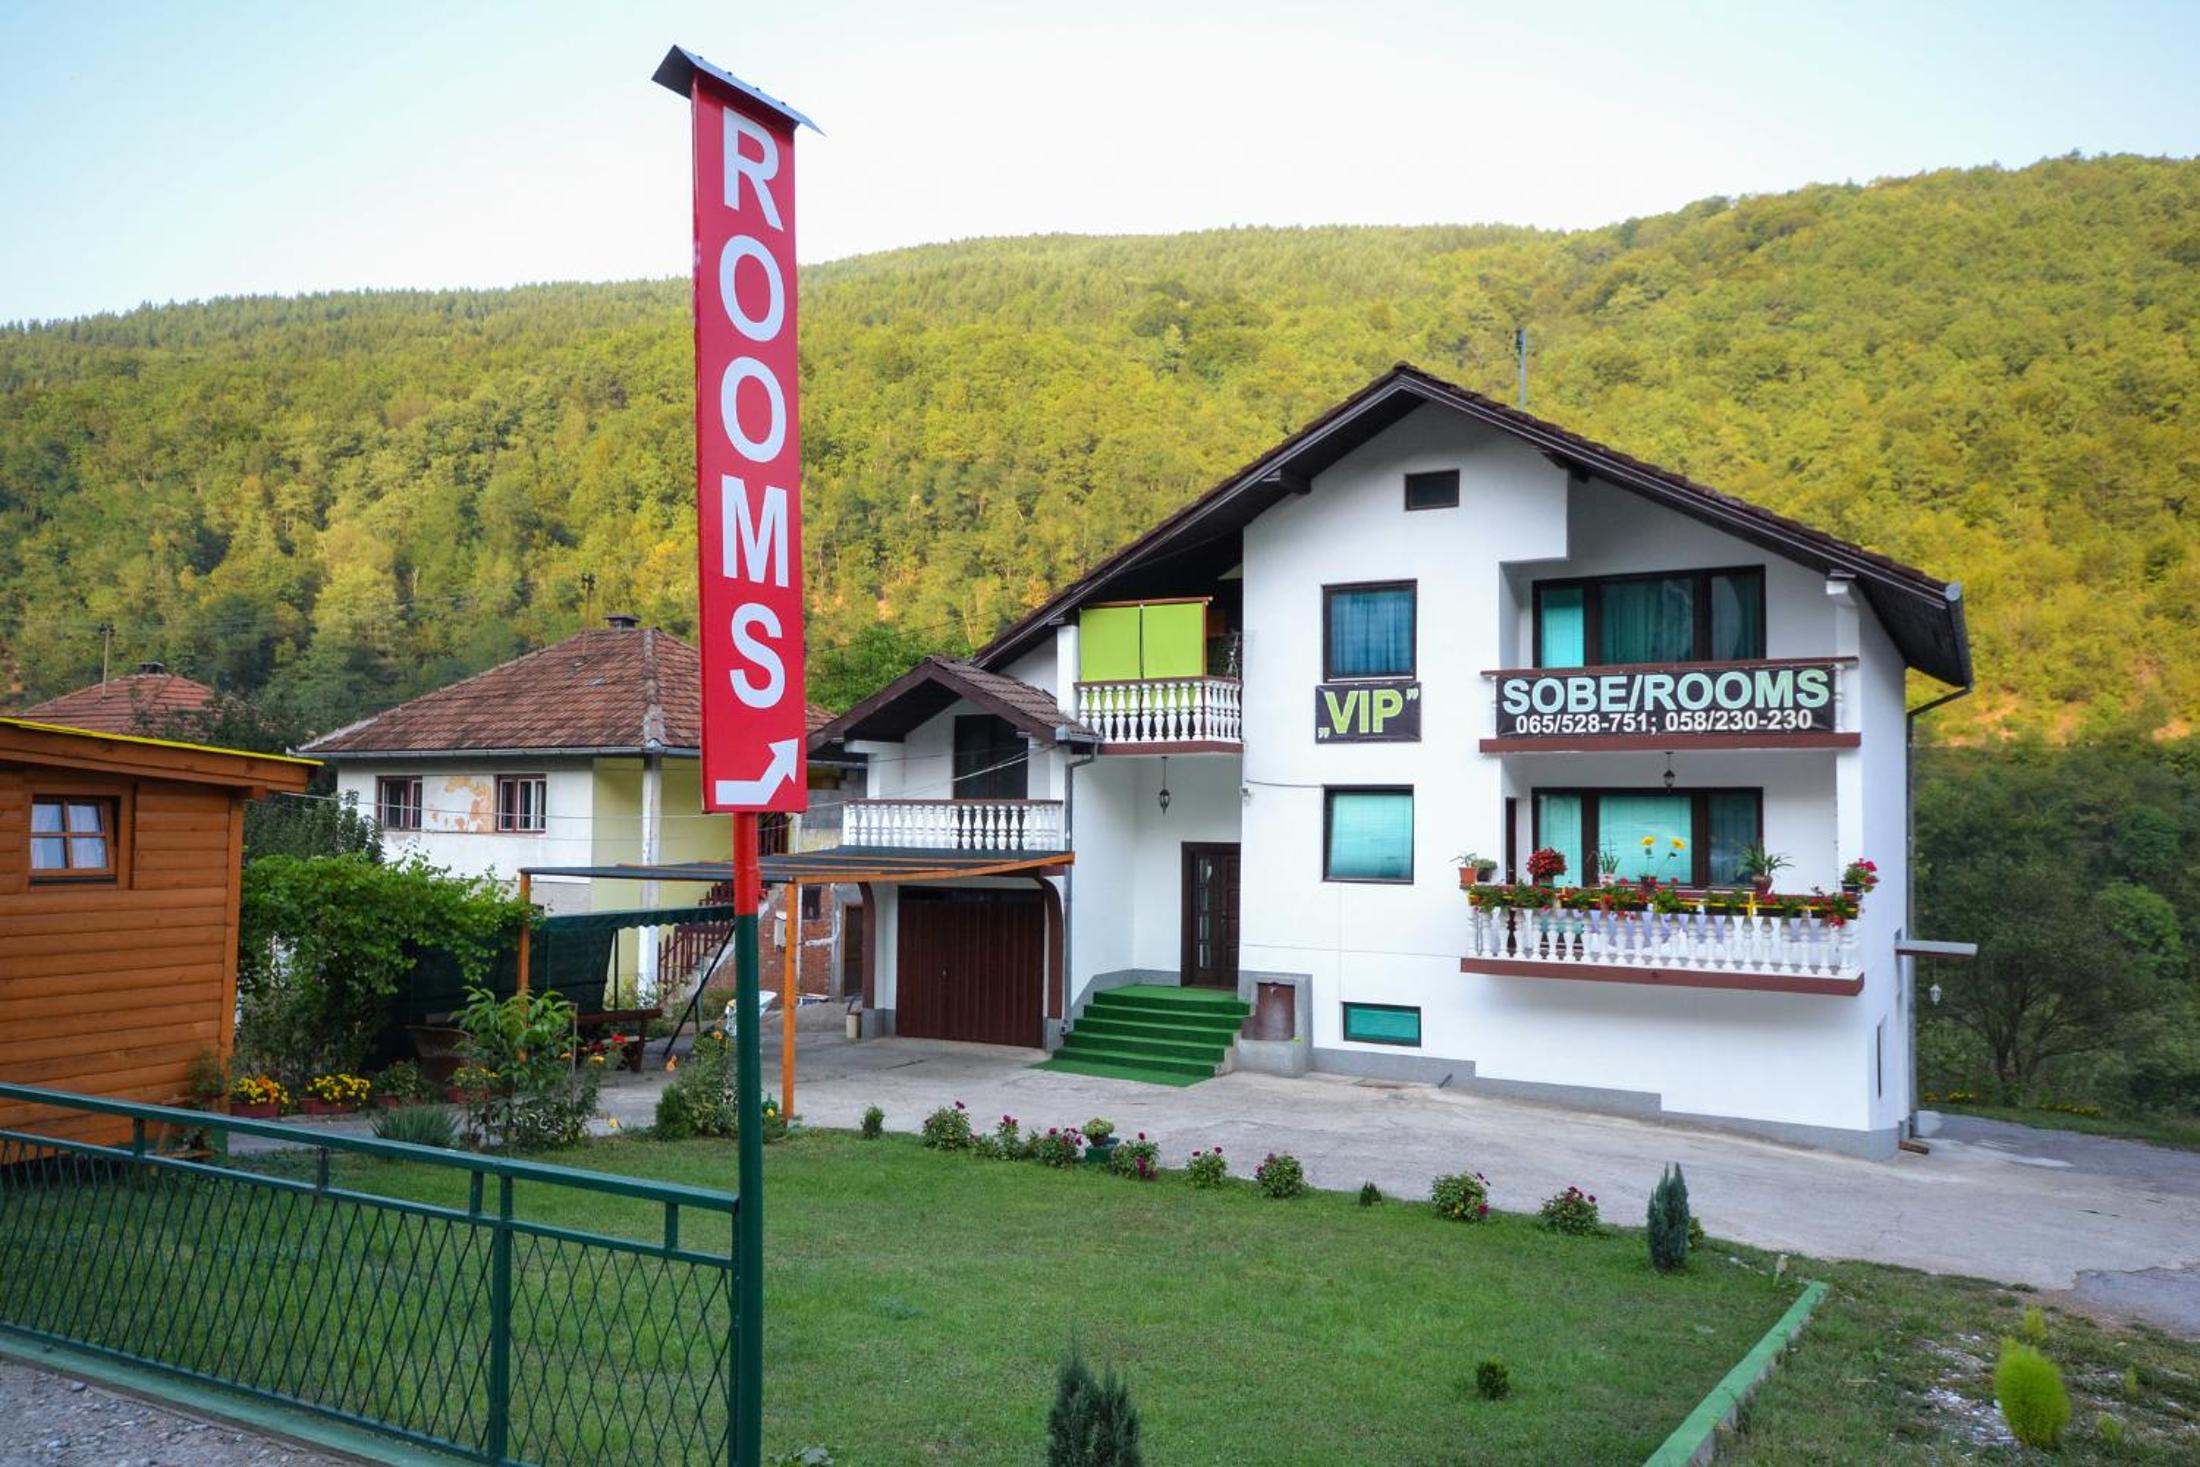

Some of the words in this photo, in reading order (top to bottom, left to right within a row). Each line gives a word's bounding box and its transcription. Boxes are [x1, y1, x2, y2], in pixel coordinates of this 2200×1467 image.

[719, 105, 789, 709] ROOMS
[1502, 668, 1830, 714] SOBE/ROOMS
[1665, 709, 1812, 731] 058/230-230
